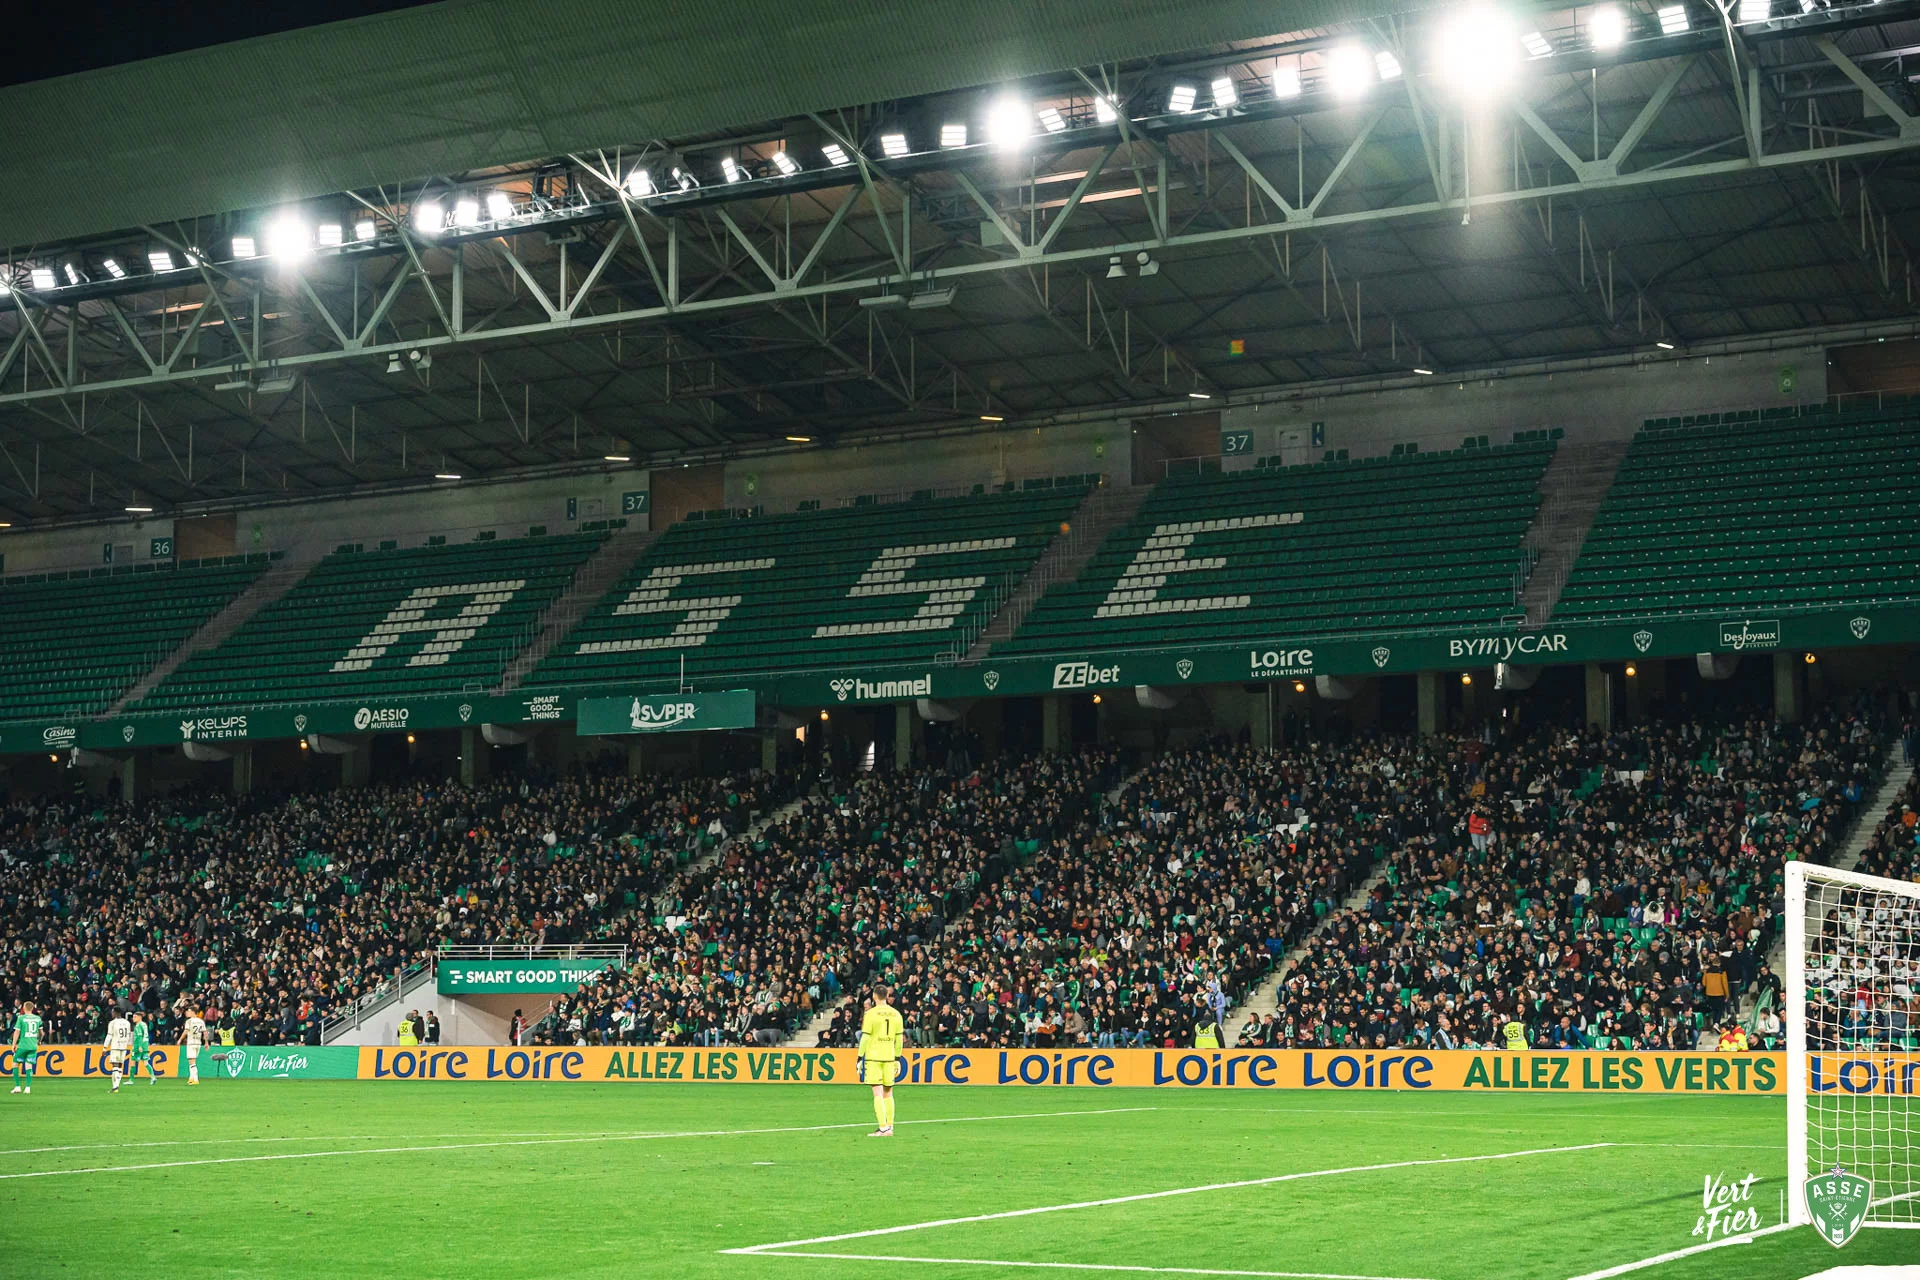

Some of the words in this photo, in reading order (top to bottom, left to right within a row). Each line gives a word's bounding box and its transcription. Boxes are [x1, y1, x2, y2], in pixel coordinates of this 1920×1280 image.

[1226, 436, 1249, 451] 37
[626, 496, 644, 510] 37
[154, 542, 170, 556] 36
[328, 512, 1304, 672] ASSE
[1251, 649, 1313, 668] Loire
[856, 674, 931, 699] hummel
[533, 696, 560, 704] SMART
[371, 708, 409, 722] AÉSIO
[530, 704, 553, 712] GOOD
[641, 702, 695, 721] SUPER
[531, 711, 560, 720] THINGS
[371, 721, 406, 729] MUTUELLE
[43, 726, 76, 740] Casino
[197, 729, 247, 739] INTERIM
[466, 970, 512, 984] SMART
[516, 970, 556, 983] GOOD
[28, 1021, 37, 1034] 10
[119, 1028, 128, 1038] 91
[885, 1019, 889, 1036] 1
[1508, 1030, 1519, 1039] 55
[257, 1054, 282, 1072] Vert
[285, 1053, 309, 1073] Fier
[374, 1049, 468, 1079] Loire
[487, 1049, 584, 1079] Loire
[604, 1051, 684, 1079] ALLEZ
[693, 1052, 738, 1081] LES
[747, 1052, 835, 1081] VERTS
[998, 1051, 1114, 1086] Loire
[1153, 1051, 1278, 1087] Loire
[1303, 1052, 1433, 1088] Loire
[1463, 1056, 1569, 1089] ALLEZ
[1582, 1057, 1643, 1090] LES
[1655, 1057, 1777, 1092] VERTS
